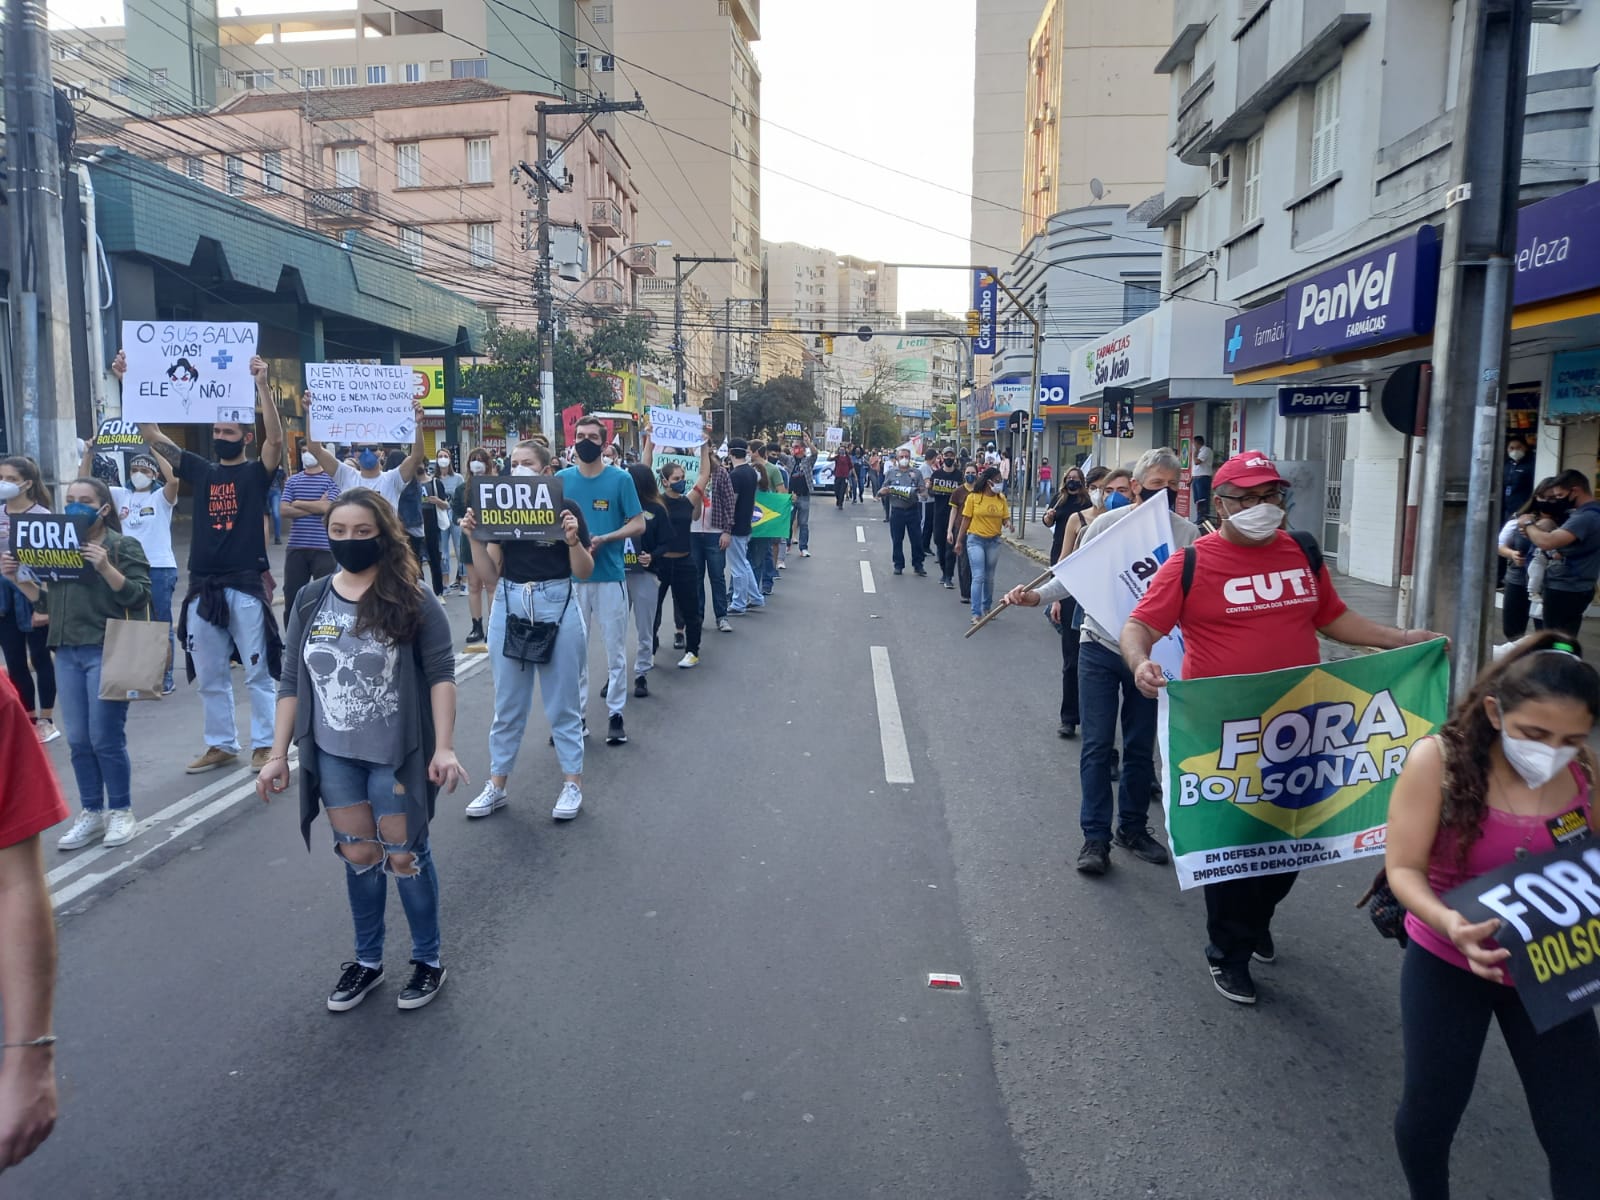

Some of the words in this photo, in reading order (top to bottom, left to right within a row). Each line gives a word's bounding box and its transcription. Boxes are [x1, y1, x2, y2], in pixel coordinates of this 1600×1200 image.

[1514, 236, 1570, 272] eleza
[1297, 252, 1397, 330] PanVel
[979, 290, 992, 349] Colombo
[1345, 315, 1387, 338] FARMÁCIAS
[137, 323, 155, 343] O
[161, 325, 198, 343] SUS
[203, 326, 254, 344] SALVA
[1254, 320, 1285, 347] farmáci
[161, 343, 202, 357] VIDAS!
[1096, 334, 1131, 360] FARMÁCIAS
[310, 367, 344, 378] NEM
[346, 366, 371, 378] TÃO
[374, 367, 409, 378] INTELI-
[1095, 360, 1109, 385] São
[1110, 351, 1130, 381] João
[140, 381, 168, 396] ELE
[309, 379, 345, 390] GENTE
[349, 380, 391, 390] QUANTO
[393, 380, 406, 390] EU
[311, 393, 337, 402] ACHO
[340, 393, 346, 402] E
[349, 393, 369, 402] NEM
[1291, 391, 1351, 406] PanVel
[311, 404, 335, 412] COMO
[337, 405, 384, 414] GOSTARIAM
[386, 406, 402, 414] QUE
[312, 412, 334, 420] FOSSE
[651, 410, 685, 427] FORA
[328, 423, 388, 439] #FORA
[933, 478, 959, 489] FORA
[479, 483, 554, 510] FORA
[481, 509, 555, 525] BOLSONARO
[16, 521, 81, 550] FORA
[16, 548, 84, 569] BOLSONARO
[1224, 568, 1306, 605] CUT
[1225, 606, 1253, 614] CENTRAL
[1253, 602, 1271, 611] ÚNICA
[1217, 688, 1408, 771] FORA
[1361, 828, 1387, 846] CU
[1205, 852, 1221, 864] EM
[1222, 847, 1266, 862] DEFESA
[1268, 844, 1288, 856] DA
[1289, 842, 1326, 853] VIDA,
[1193, 863, 1249, 881] EMPREGOS
[1250, 862, 1259, 872] E
[1260, 849, 1342, 870] DEMOCRACIA
